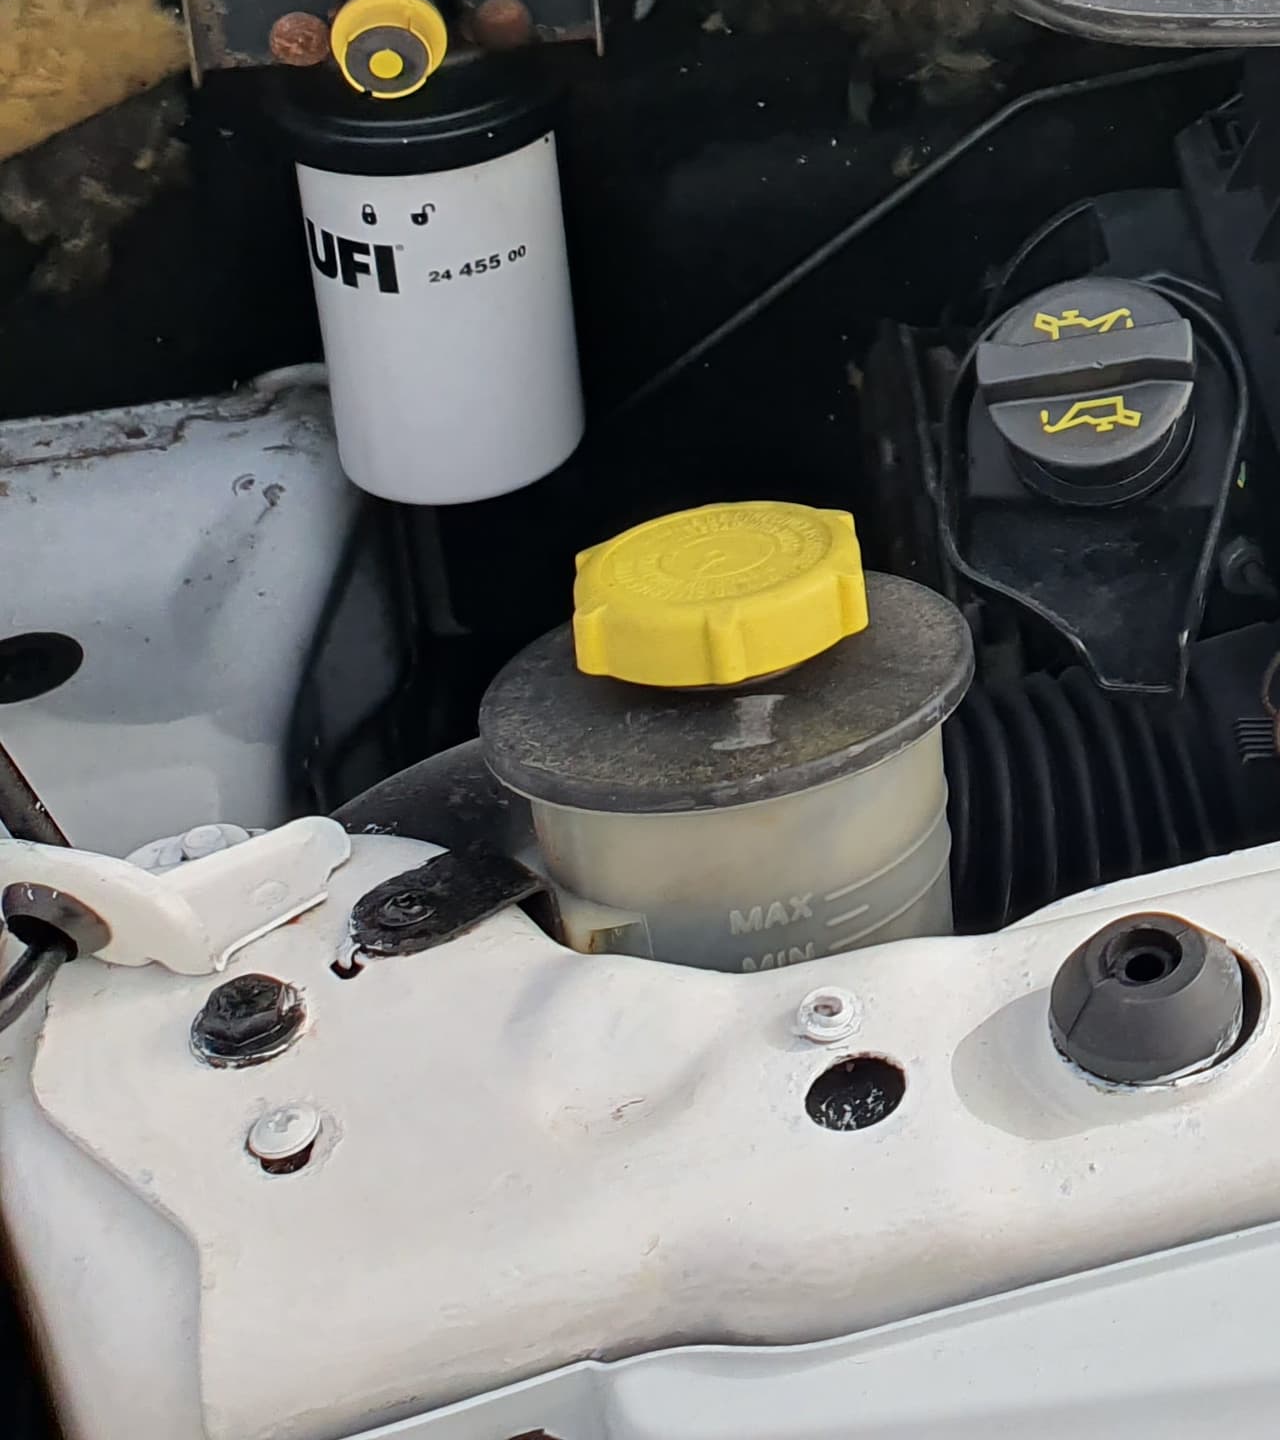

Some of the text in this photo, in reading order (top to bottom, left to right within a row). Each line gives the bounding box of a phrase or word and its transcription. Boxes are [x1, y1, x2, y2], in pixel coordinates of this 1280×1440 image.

[305, 217, 400, 294] UFI
[428, 245, 527, 283] 24 455 00
[729, 891, 813, 936] MAX
